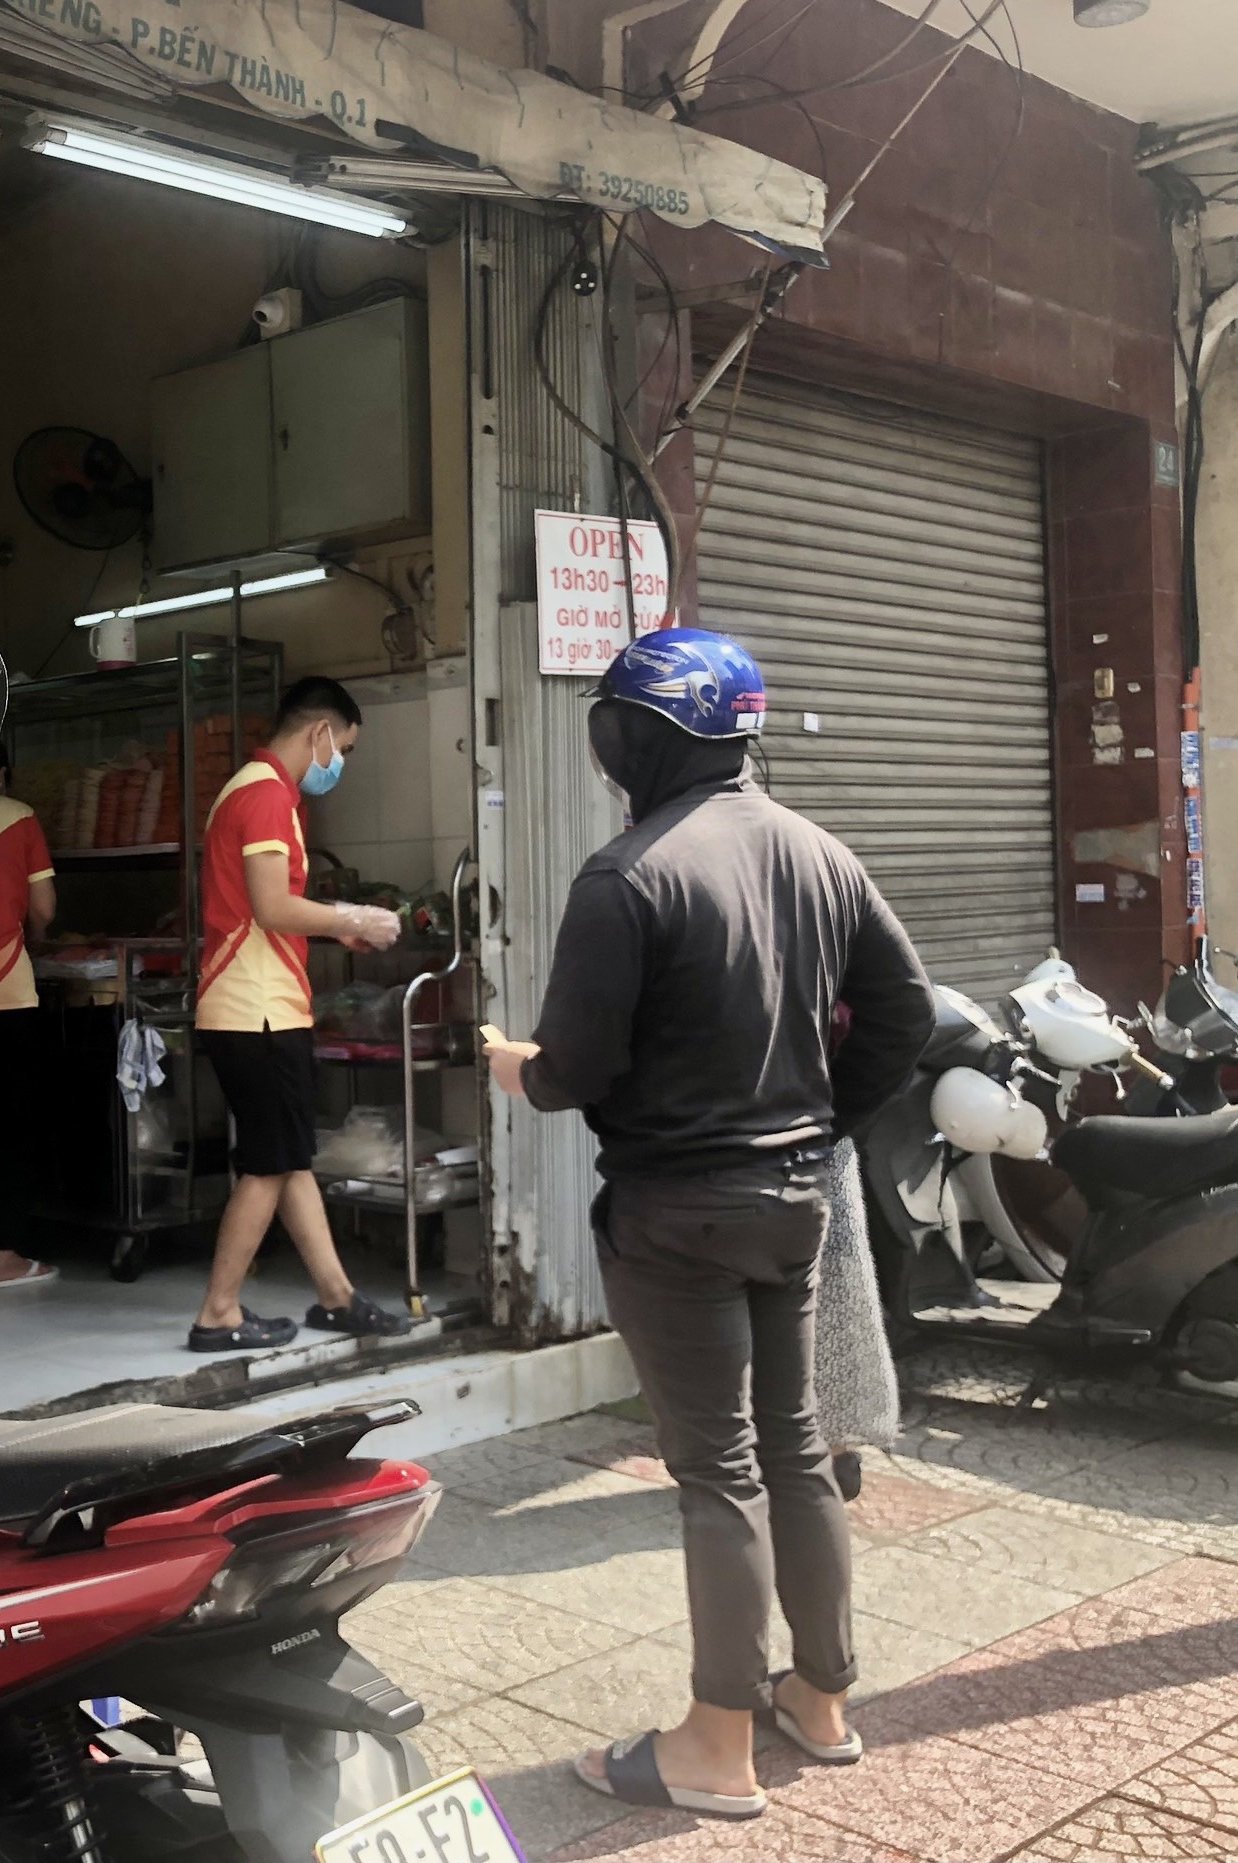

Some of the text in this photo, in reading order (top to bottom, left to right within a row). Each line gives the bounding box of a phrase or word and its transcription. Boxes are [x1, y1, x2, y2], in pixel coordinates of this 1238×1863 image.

[224, 50, 307, 108] THÀNH
[330, 90, 368, 127] Q.1
[599, 171, 689, 215] 39250885
[569, 526, 644, 560] OPEN
[551, 567, 666, 596] 13h30 23h
[556, 605, 589, 627] GIỜ
[594, 605, 622, 629] MỞ
[548, 637, 563, 658] 13
[568, 638, 593, 664] giờ
[270, 1628, 321, 1654] HONDA
